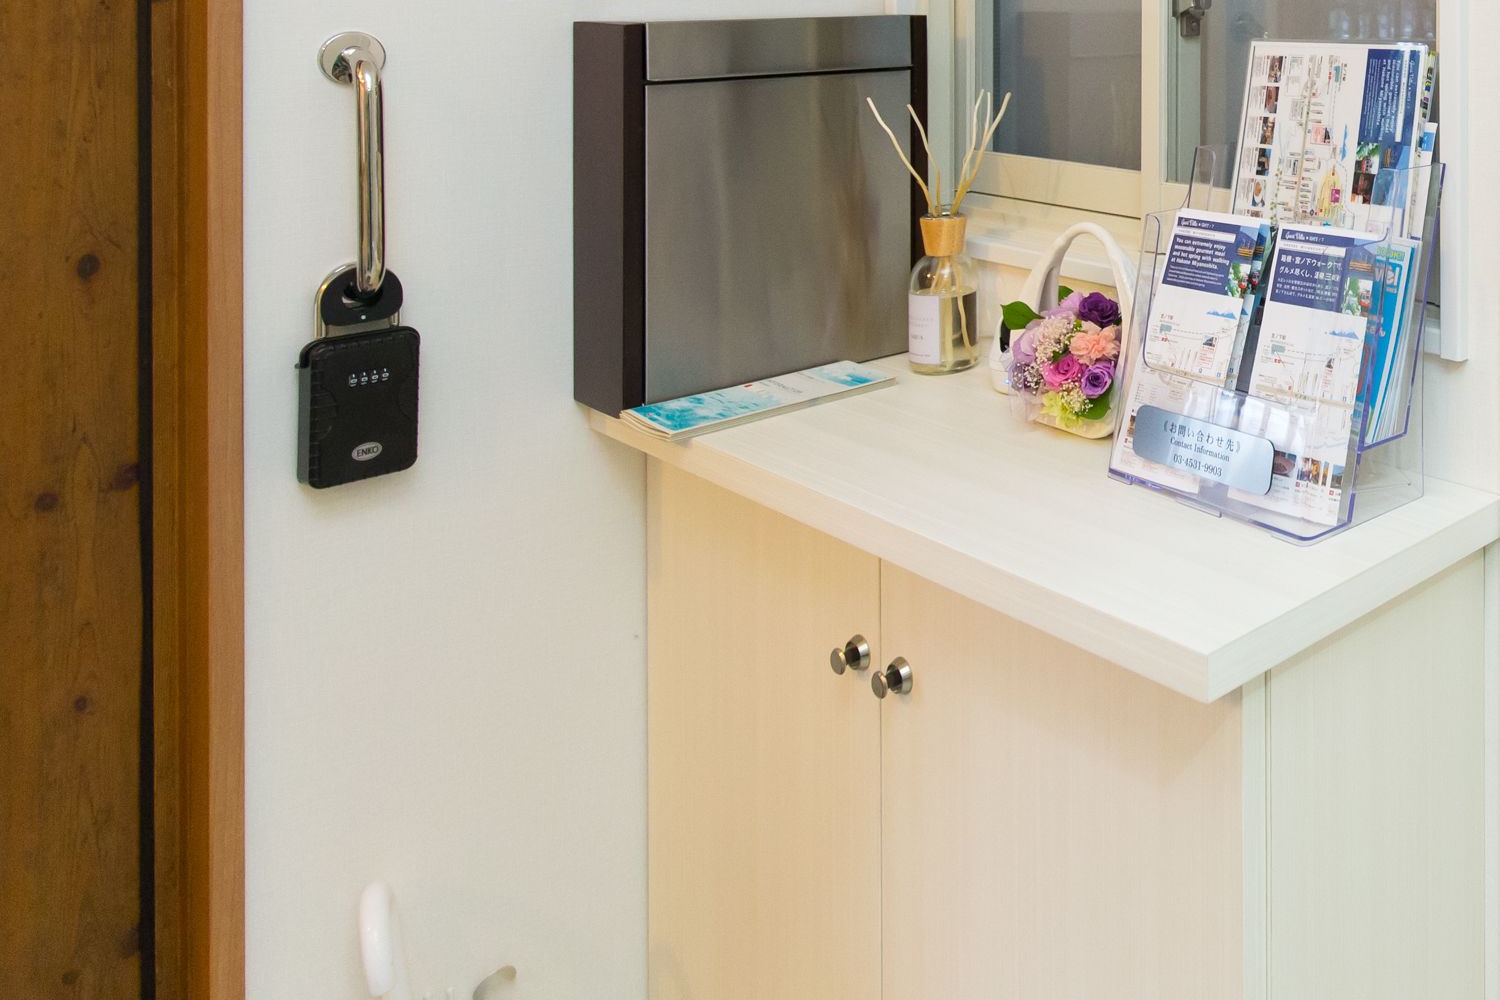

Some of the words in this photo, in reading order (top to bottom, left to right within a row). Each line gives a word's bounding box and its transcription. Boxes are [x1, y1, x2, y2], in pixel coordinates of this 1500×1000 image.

[356, 445, 379, 457] ENKO
[1170, 437, 1193, 451] Contact
[1194, 443, 1230, 462] Information
[1173, 453, 1222, 477] 03-4531-9903
